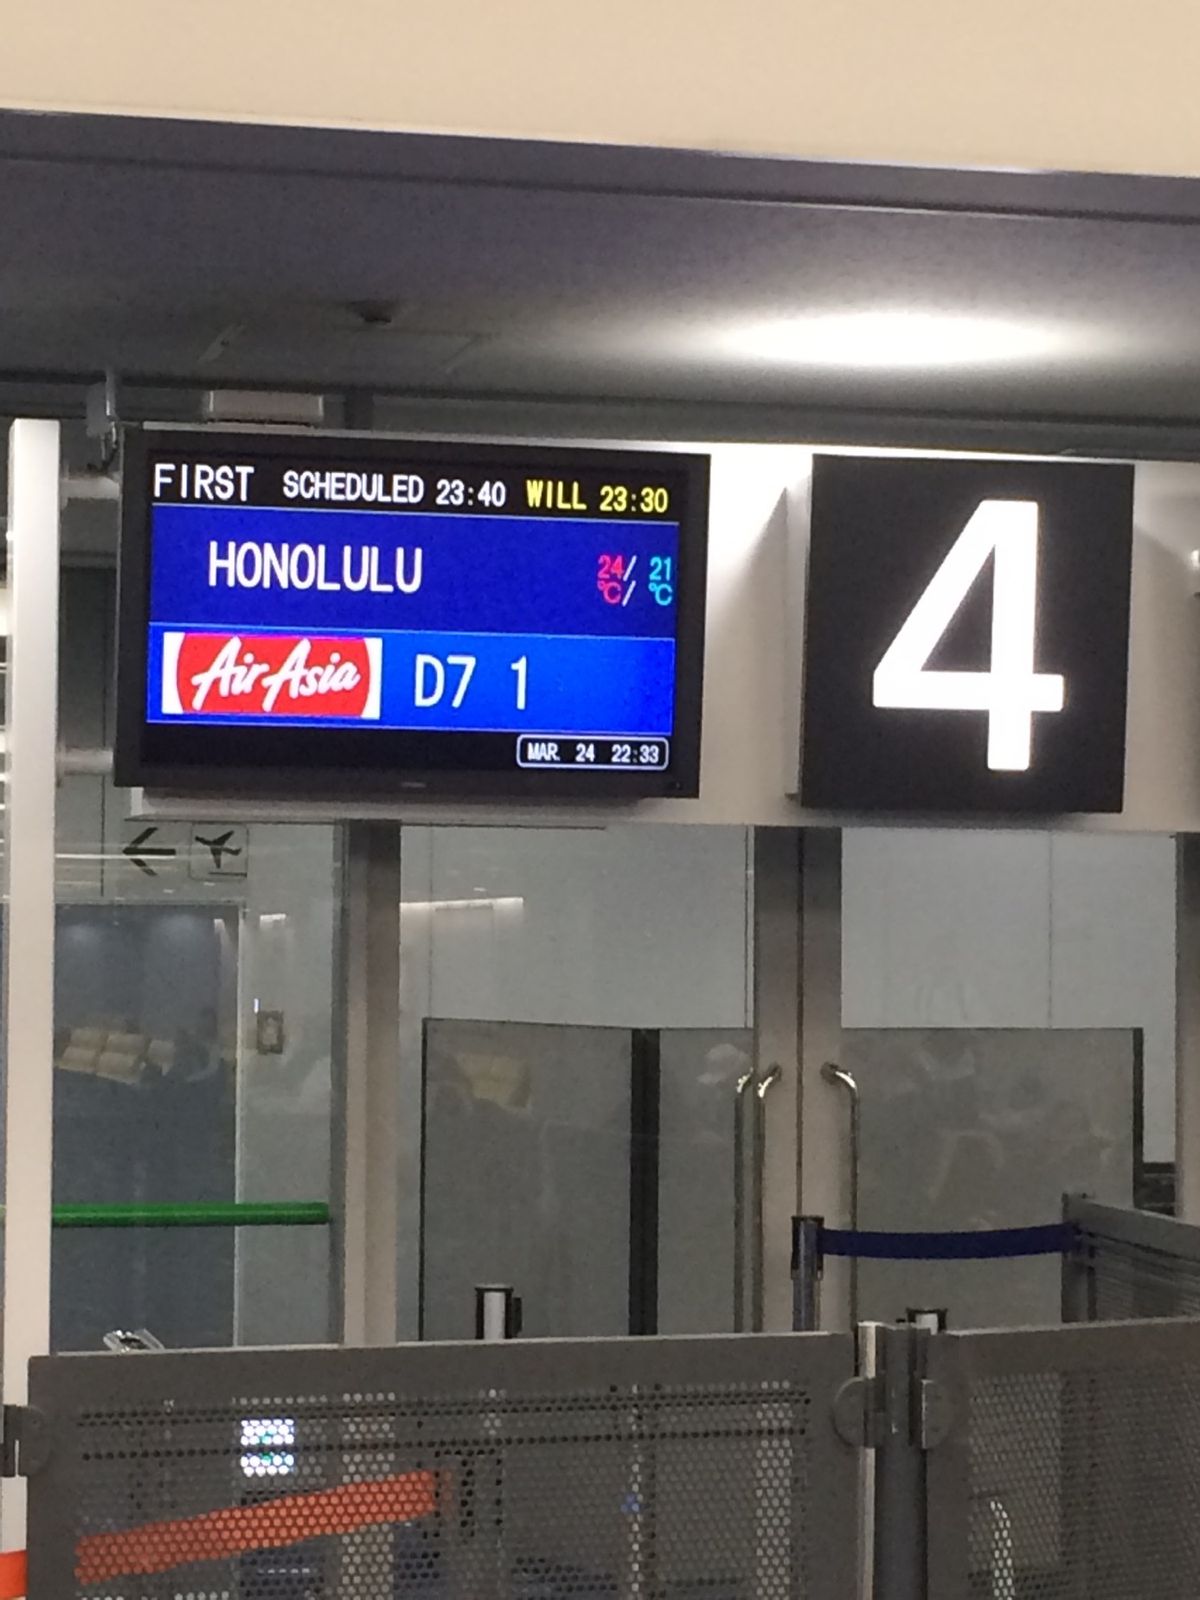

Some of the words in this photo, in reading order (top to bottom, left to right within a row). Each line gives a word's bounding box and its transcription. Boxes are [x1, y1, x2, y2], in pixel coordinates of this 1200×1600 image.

[153, 463, 255, 502] FIRST
[282, 470, 425, 505] SCHEDULED
[435, 479, 507, 508] 23:40
[526, 480, 588, 511] WILL
[599, 484, 669, 514] 23:30
[208, 540, 423, 594] HONOLULU
[649, 556, 671, 581] 21
[872, 499, 1065, 772] 4
[415, 653, 477, 710] D7
[510, 655, 529, 711] 1
[575, 743, 595, 763] 24
[611, 744, 660, 764] 22:33
